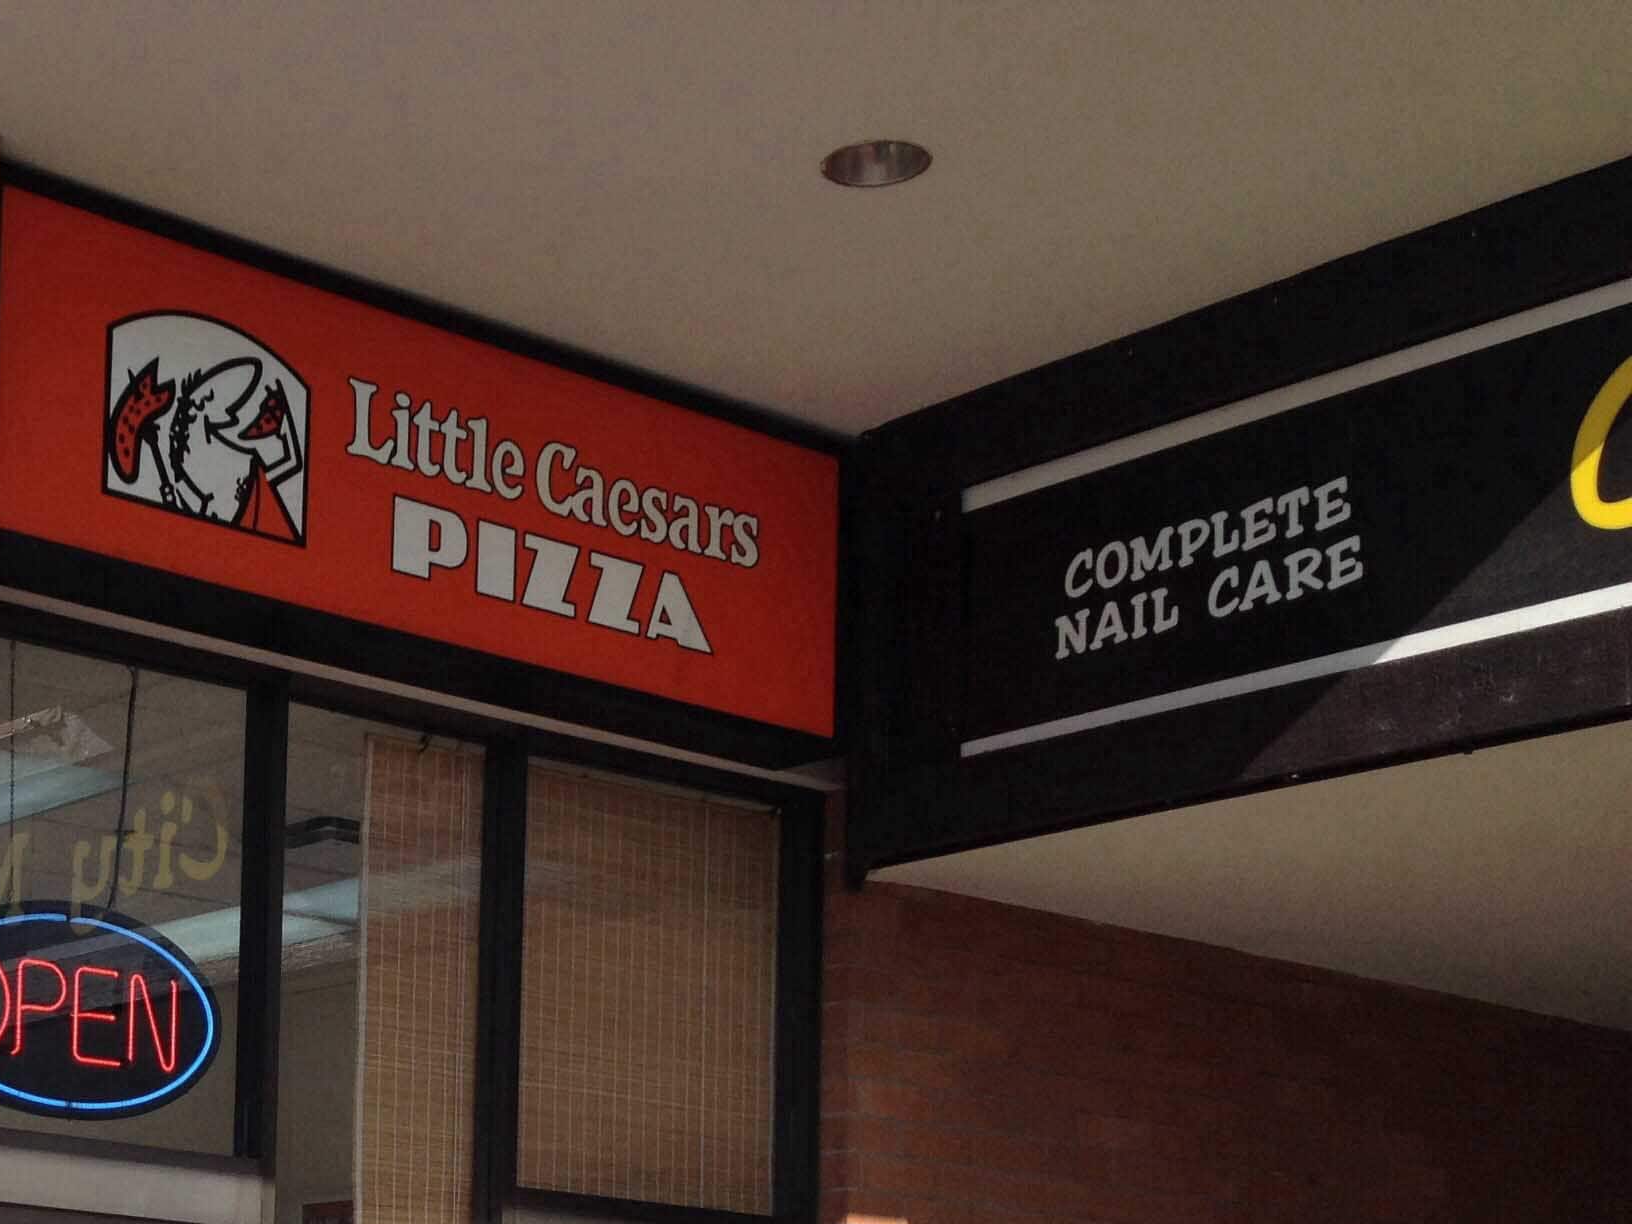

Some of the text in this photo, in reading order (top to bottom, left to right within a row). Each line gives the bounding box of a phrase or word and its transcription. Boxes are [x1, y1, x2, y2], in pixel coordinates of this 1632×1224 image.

[346, 376, 762, 569] Little Caesars
[1065, 476, 1352, 599] COMPLETE
[391, 493, 714, 655] PIZZA
[1054, 535, 1364, 660] NAIL CARE
